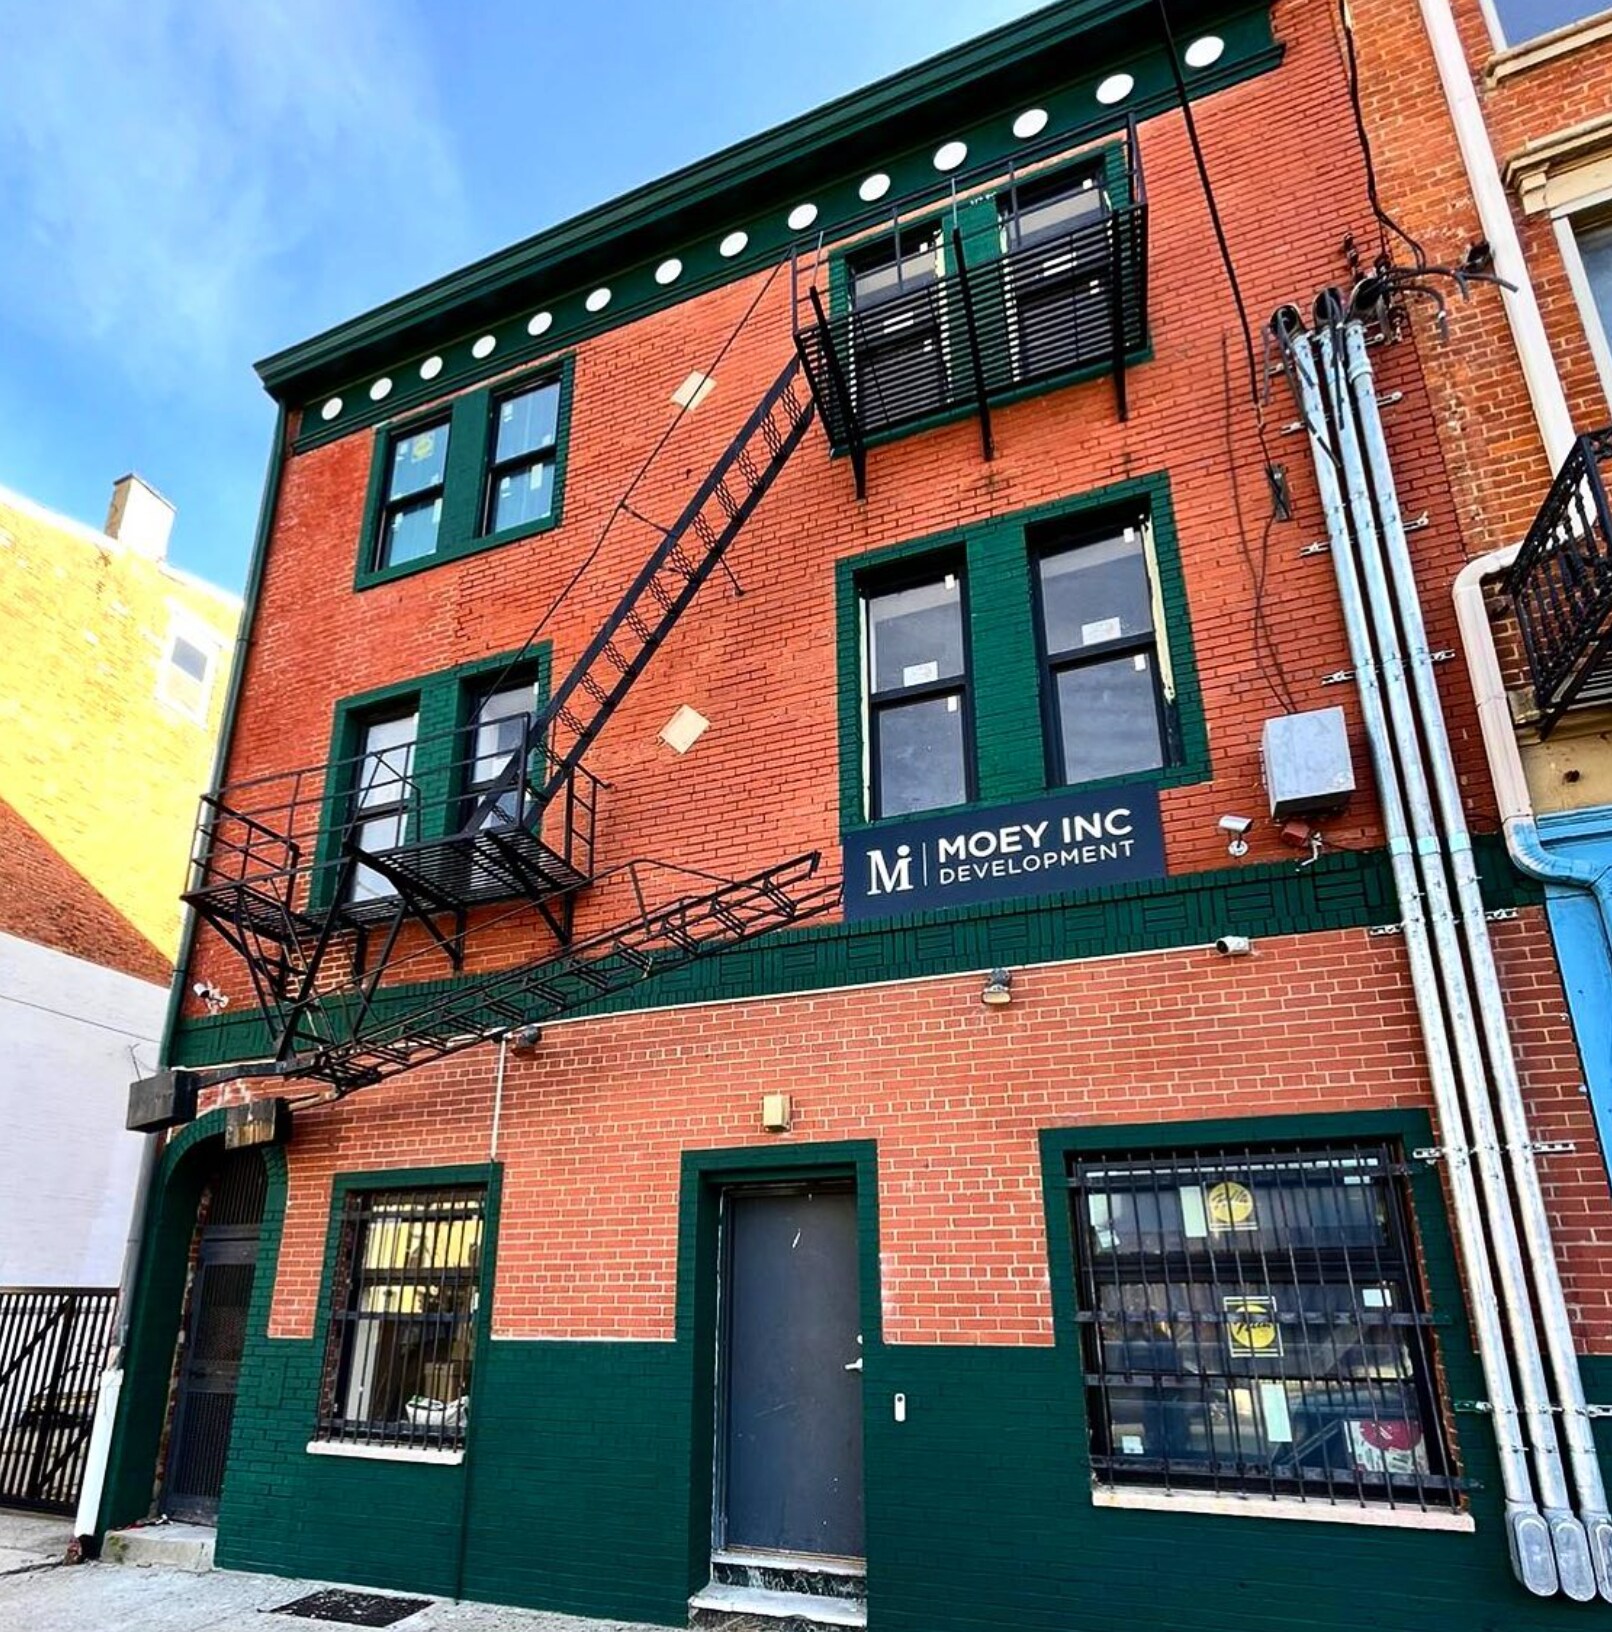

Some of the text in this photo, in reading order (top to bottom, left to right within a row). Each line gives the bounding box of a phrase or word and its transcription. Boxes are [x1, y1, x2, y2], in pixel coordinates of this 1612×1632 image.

[938, 808, 1134, 863] MOEY INC
[939, 839, 1135, 885] DEVELOPMENT
